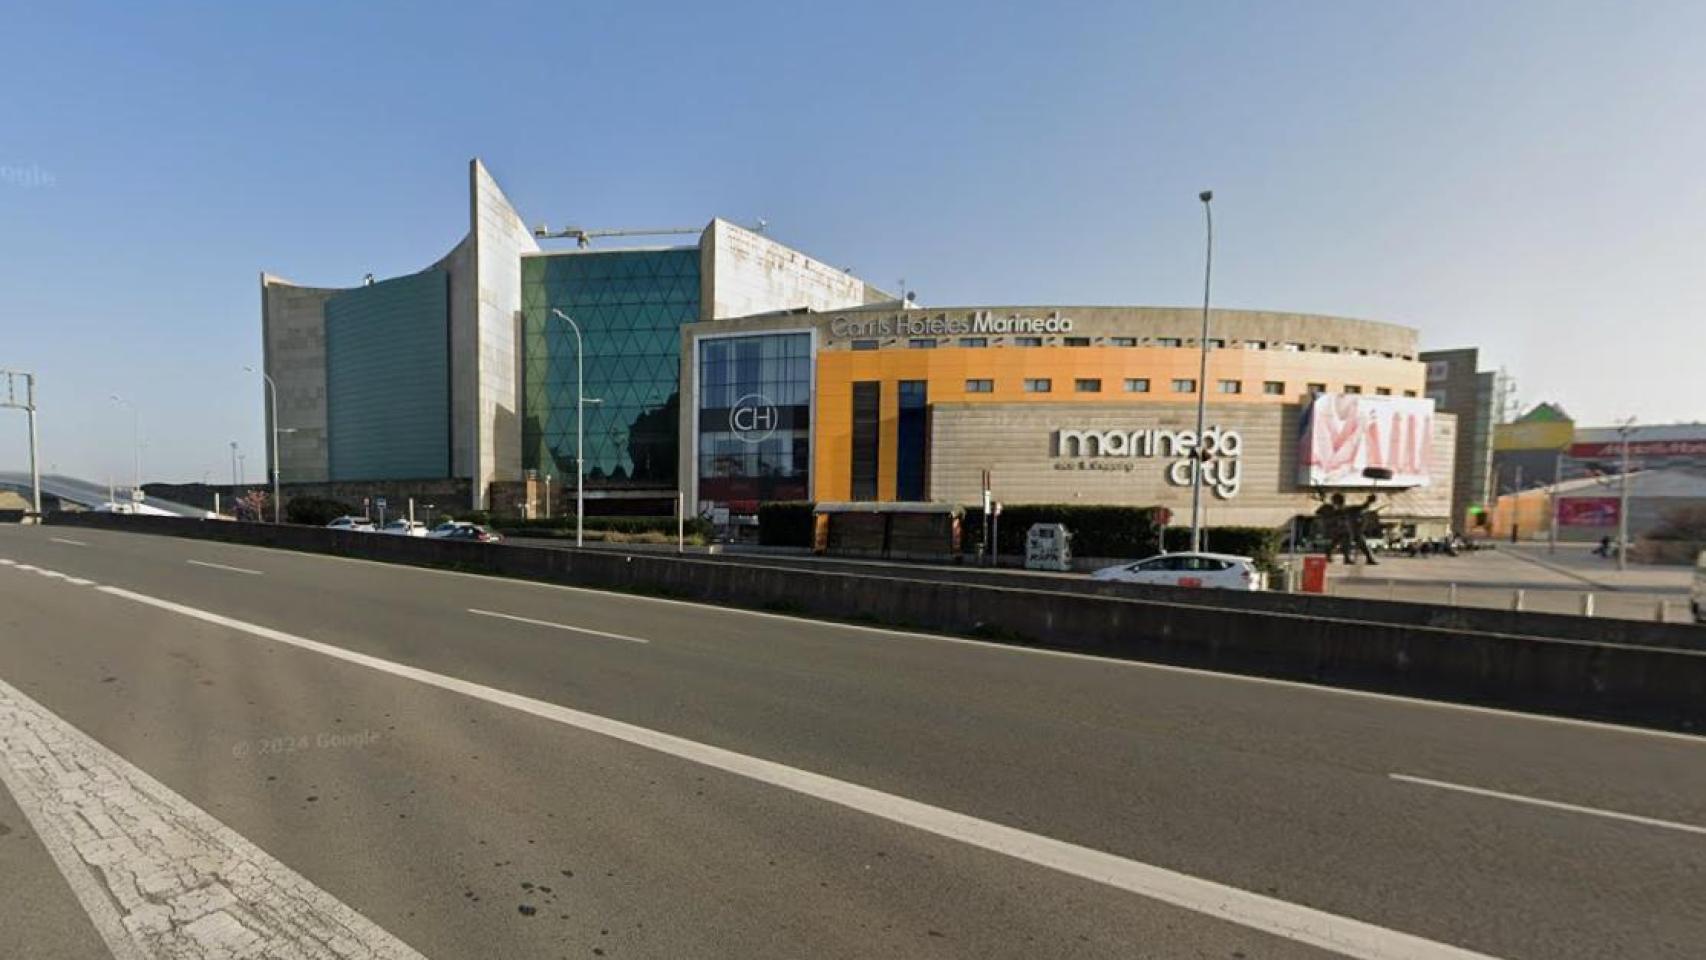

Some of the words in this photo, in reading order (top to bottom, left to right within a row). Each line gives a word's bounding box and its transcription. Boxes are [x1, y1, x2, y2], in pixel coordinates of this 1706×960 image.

[831, 315, 891, 337] Carris
[896, 311, 969, 335] Hoteles
[973, 310, 1073, 333] Marineda
[734, 406, 770, 431] CH
[1055, 425, 1242, 457] marineda
[1168, 457, 1240, 499] city
